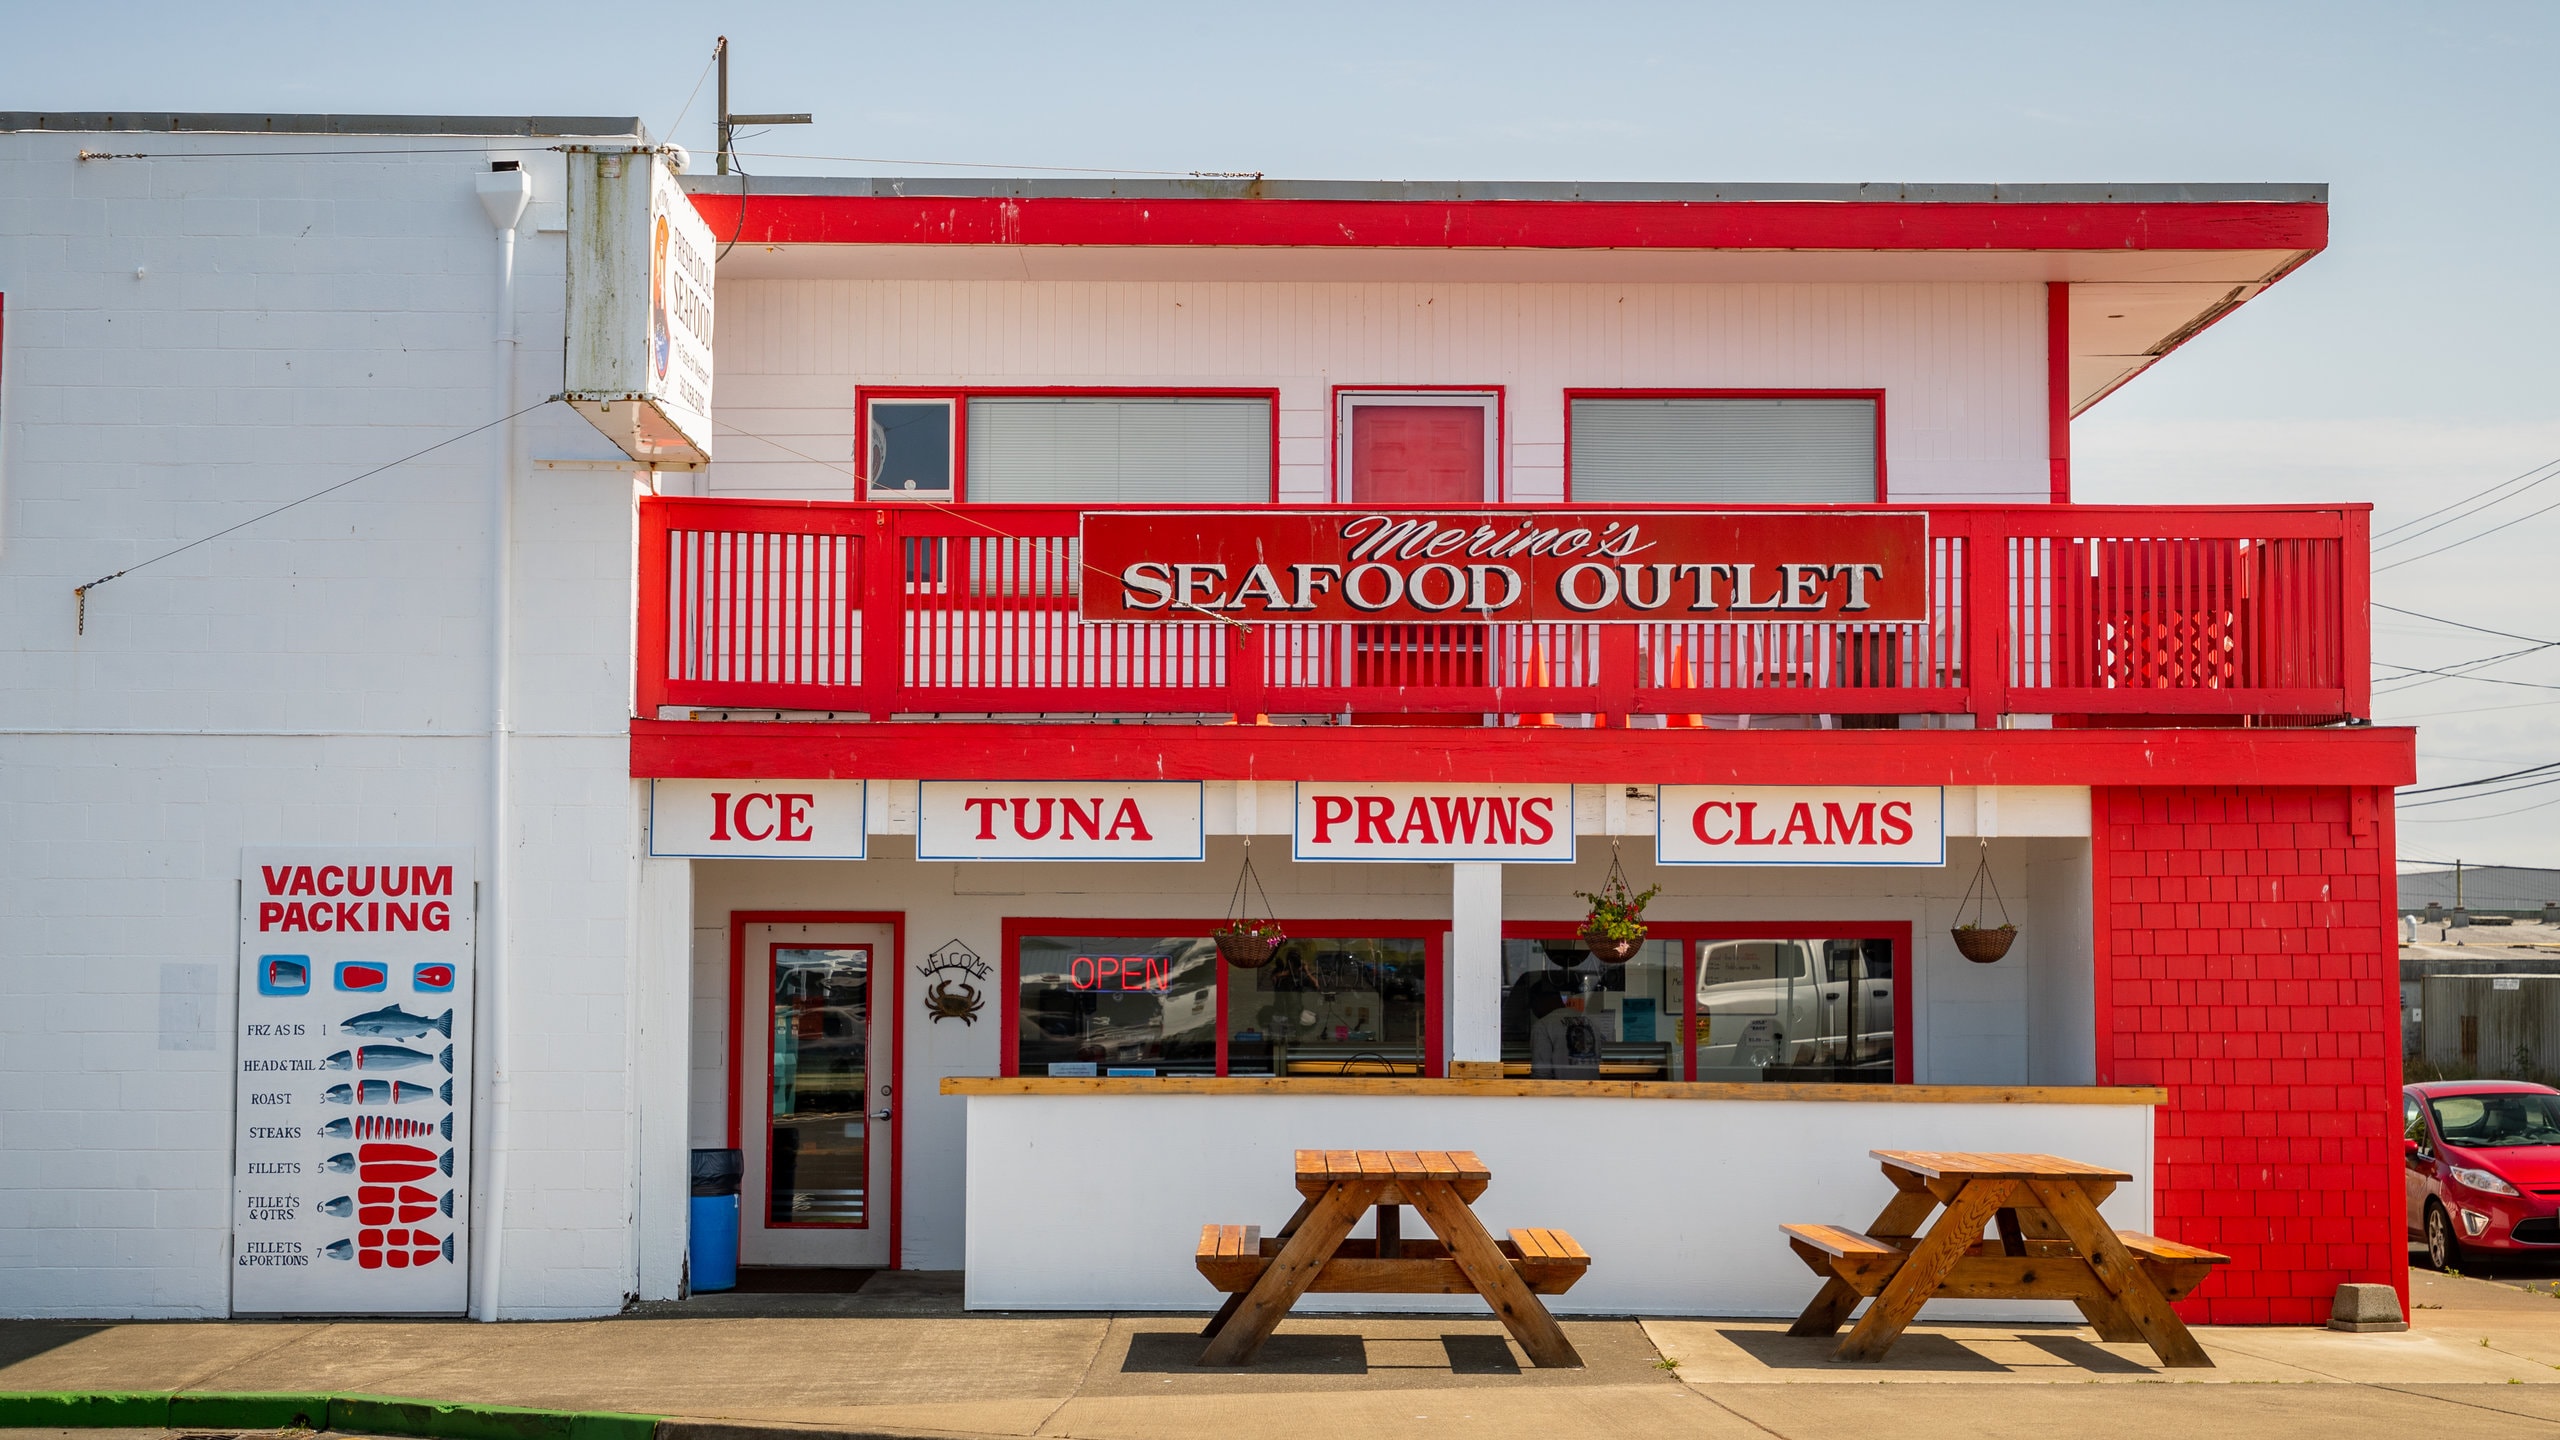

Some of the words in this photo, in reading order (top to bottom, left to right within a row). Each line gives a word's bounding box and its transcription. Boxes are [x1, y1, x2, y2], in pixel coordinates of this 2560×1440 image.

[674, 226, 694, 278] FRESH
[694, 250, 712, 301] LOCAL
[674, 270, 712, 352] SEAFOOD
[1342, 515, 1657, 561] Merino's
[1123, 562, 1523, 613] SEAFOOD
[1557, 562, 1885, 612] OUTLET
[709, 792, 814, 842] ICE
[964, 797, 1153, 841] TUNA
[1311, 795, 1554, 846] PRAWNS
[1691, 800, 1914, 846] CLAMS
[261, 865, 453, 897] VACUUM
[259, 900, 451, 933] PACKING
[916, 952, 994, 982] WELCOME
[1071, 957, 1169, 990] OPEN
[247, 1024, 271, 1036] FRZ
[274, 1024, 291, 1036] AS
[293, 1024, 305, 1036] IS
[322, 1023, 327, 1036] 1
[318, 1059, 326, 1071] 2
[251, 1092, 292, 1105] ROAST
[319, 1093, 326, 1104] 3
[249, 1126, 302, 1139] STEAKS
[316, 1127, 325, 1139] 4
[248, 1162, 301, 1174] FILLETS
[317, 1162, 325, 1174] 5
[247, 1195, 300, 1208] FILLETS
[316, 1200, 324, 1213] 6
[247, 1241, 302, 1254] FILLETS
[316, 1247, 323, 1259] 7
